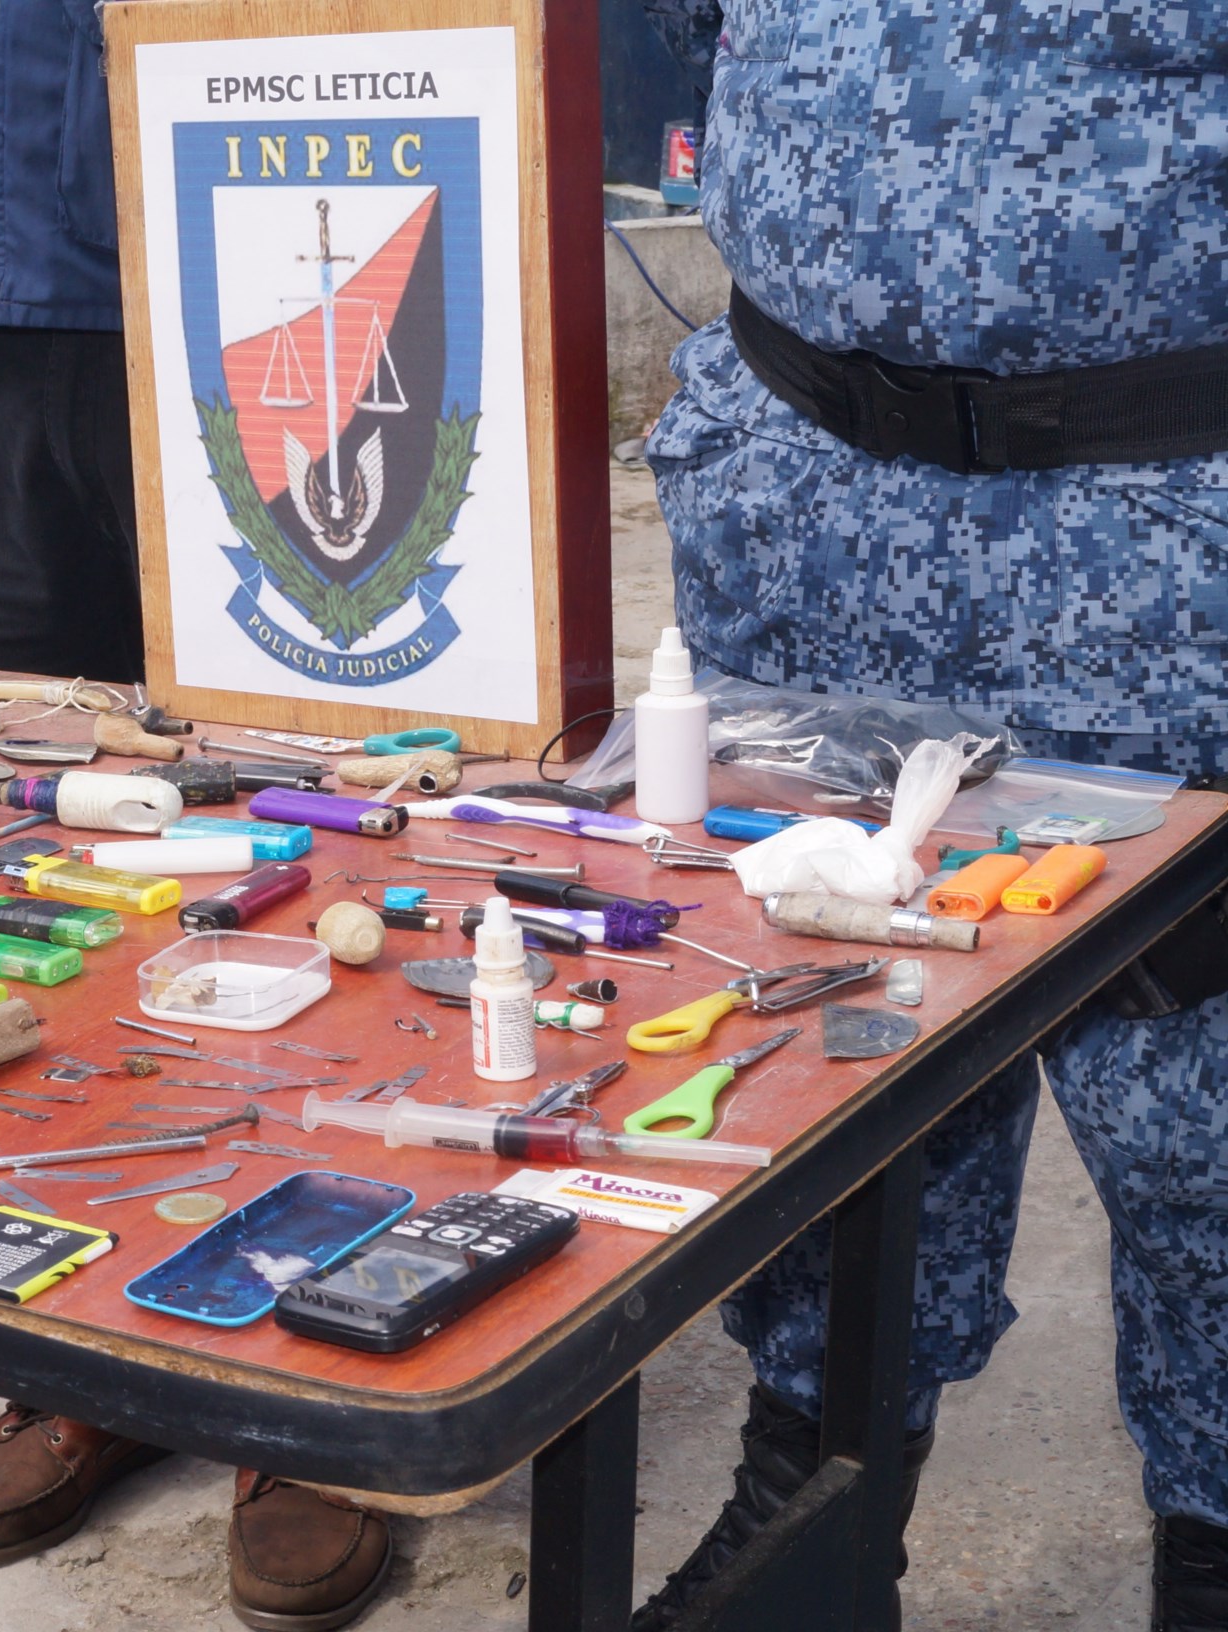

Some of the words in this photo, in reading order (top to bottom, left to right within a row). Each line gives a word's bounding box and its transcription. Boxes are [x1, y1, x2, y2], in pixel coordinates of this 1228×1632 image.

[207, 75, 305, 104] EPMSC
[315, 71, 439, 101] LETICIA
[225, 133, 422, 178] INPEC
[247, 612, 327, 674] POLICIA
[337, 636, 434, 678] JUDICIAL
[569, 1174, 683, 1202] Minora
[578, 1206, 621, 1224] Minora
